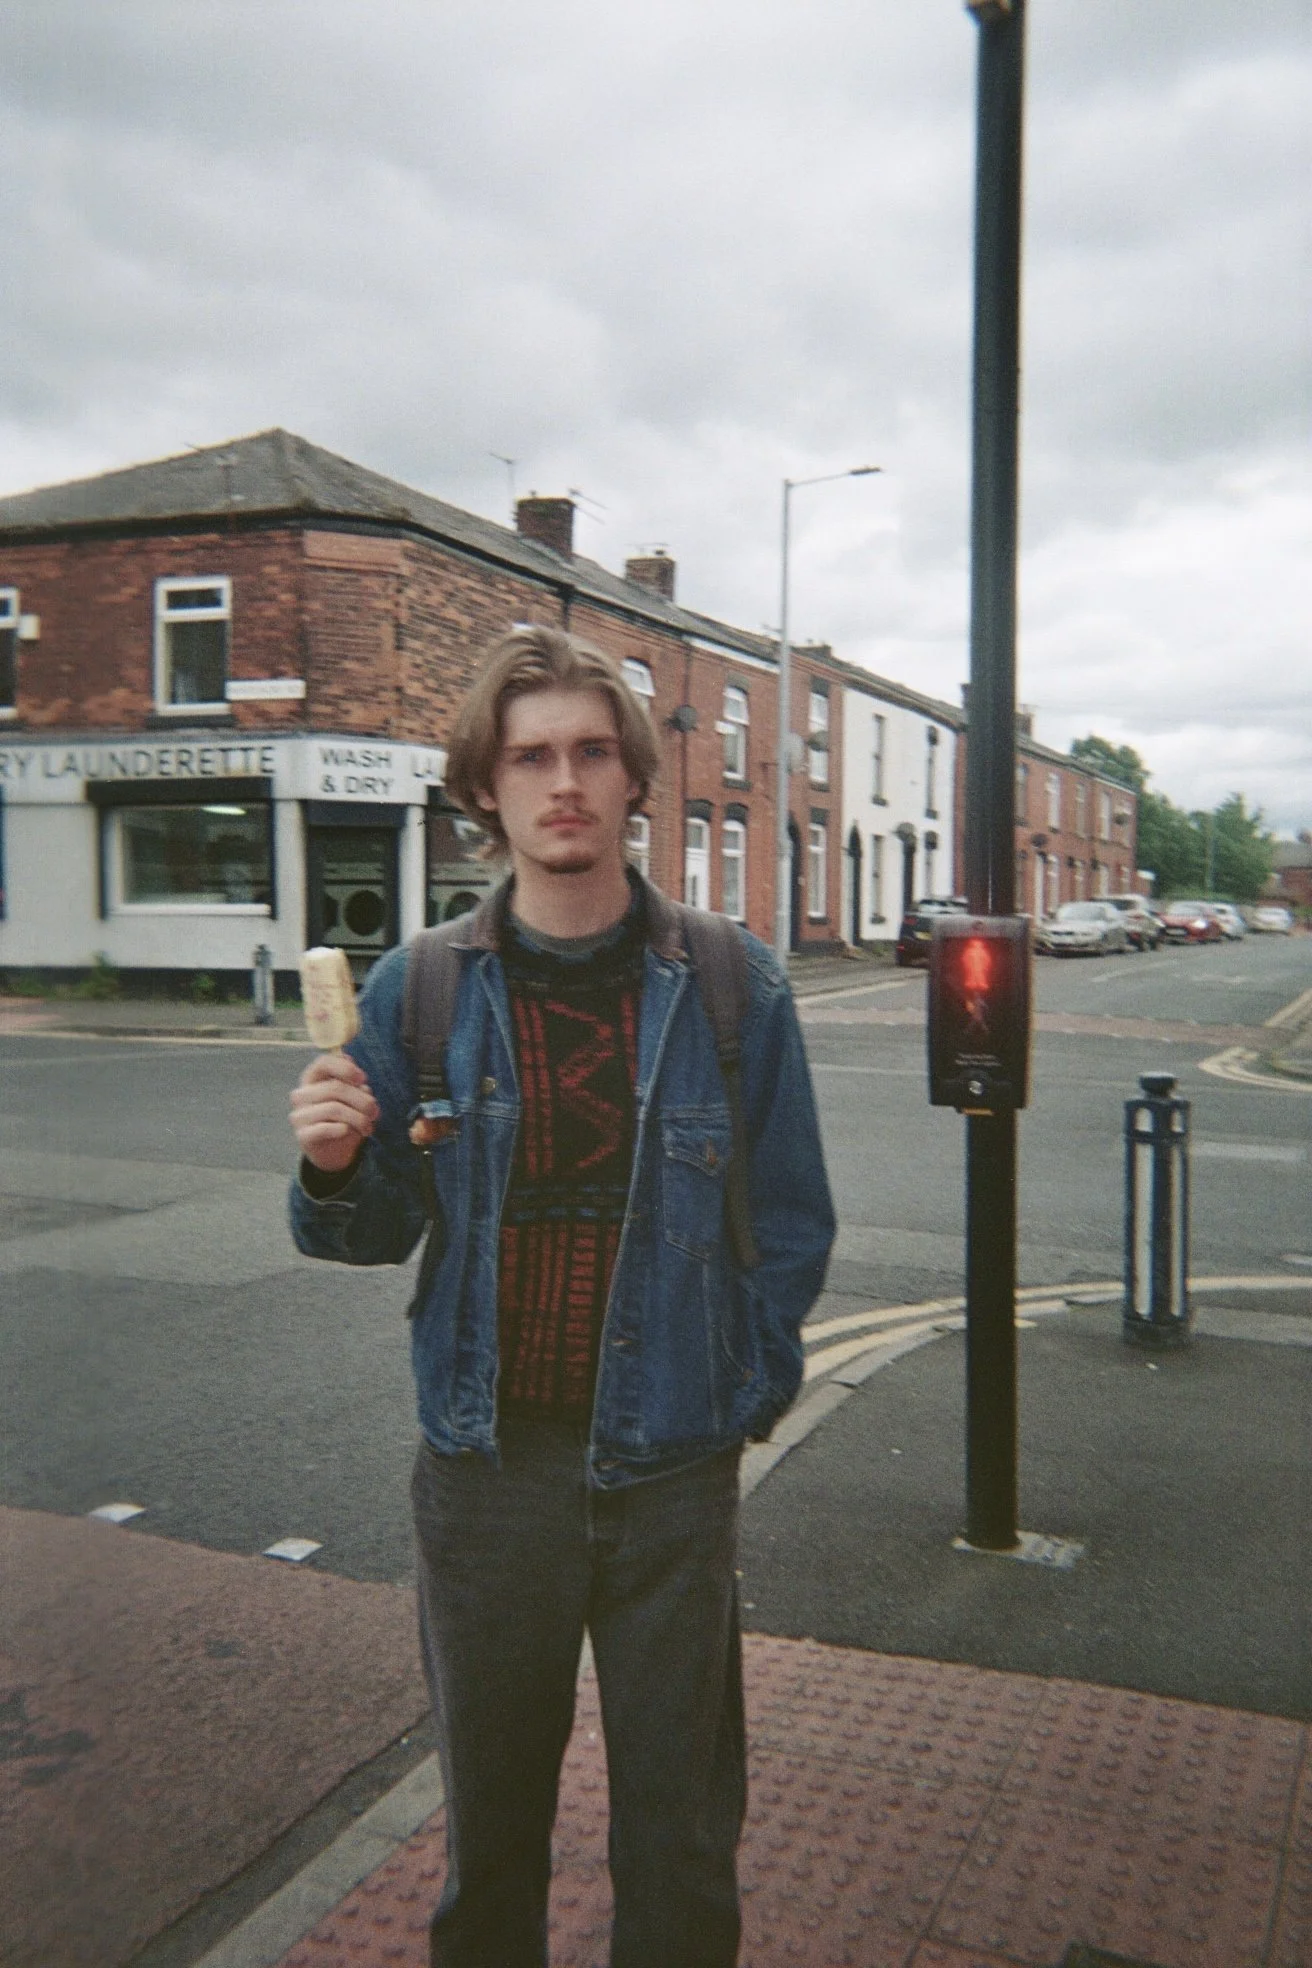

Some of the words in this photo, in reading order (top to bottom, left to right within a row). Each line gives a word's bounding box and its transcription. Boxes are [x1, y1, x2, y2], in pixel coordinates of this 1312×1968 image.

[42, 747, 275, 778] LAUNDERETTE
[319, 748, 392, 768] WASH
[321, 774, 336, 793] &
[343, 776, 395, 795] DRY
